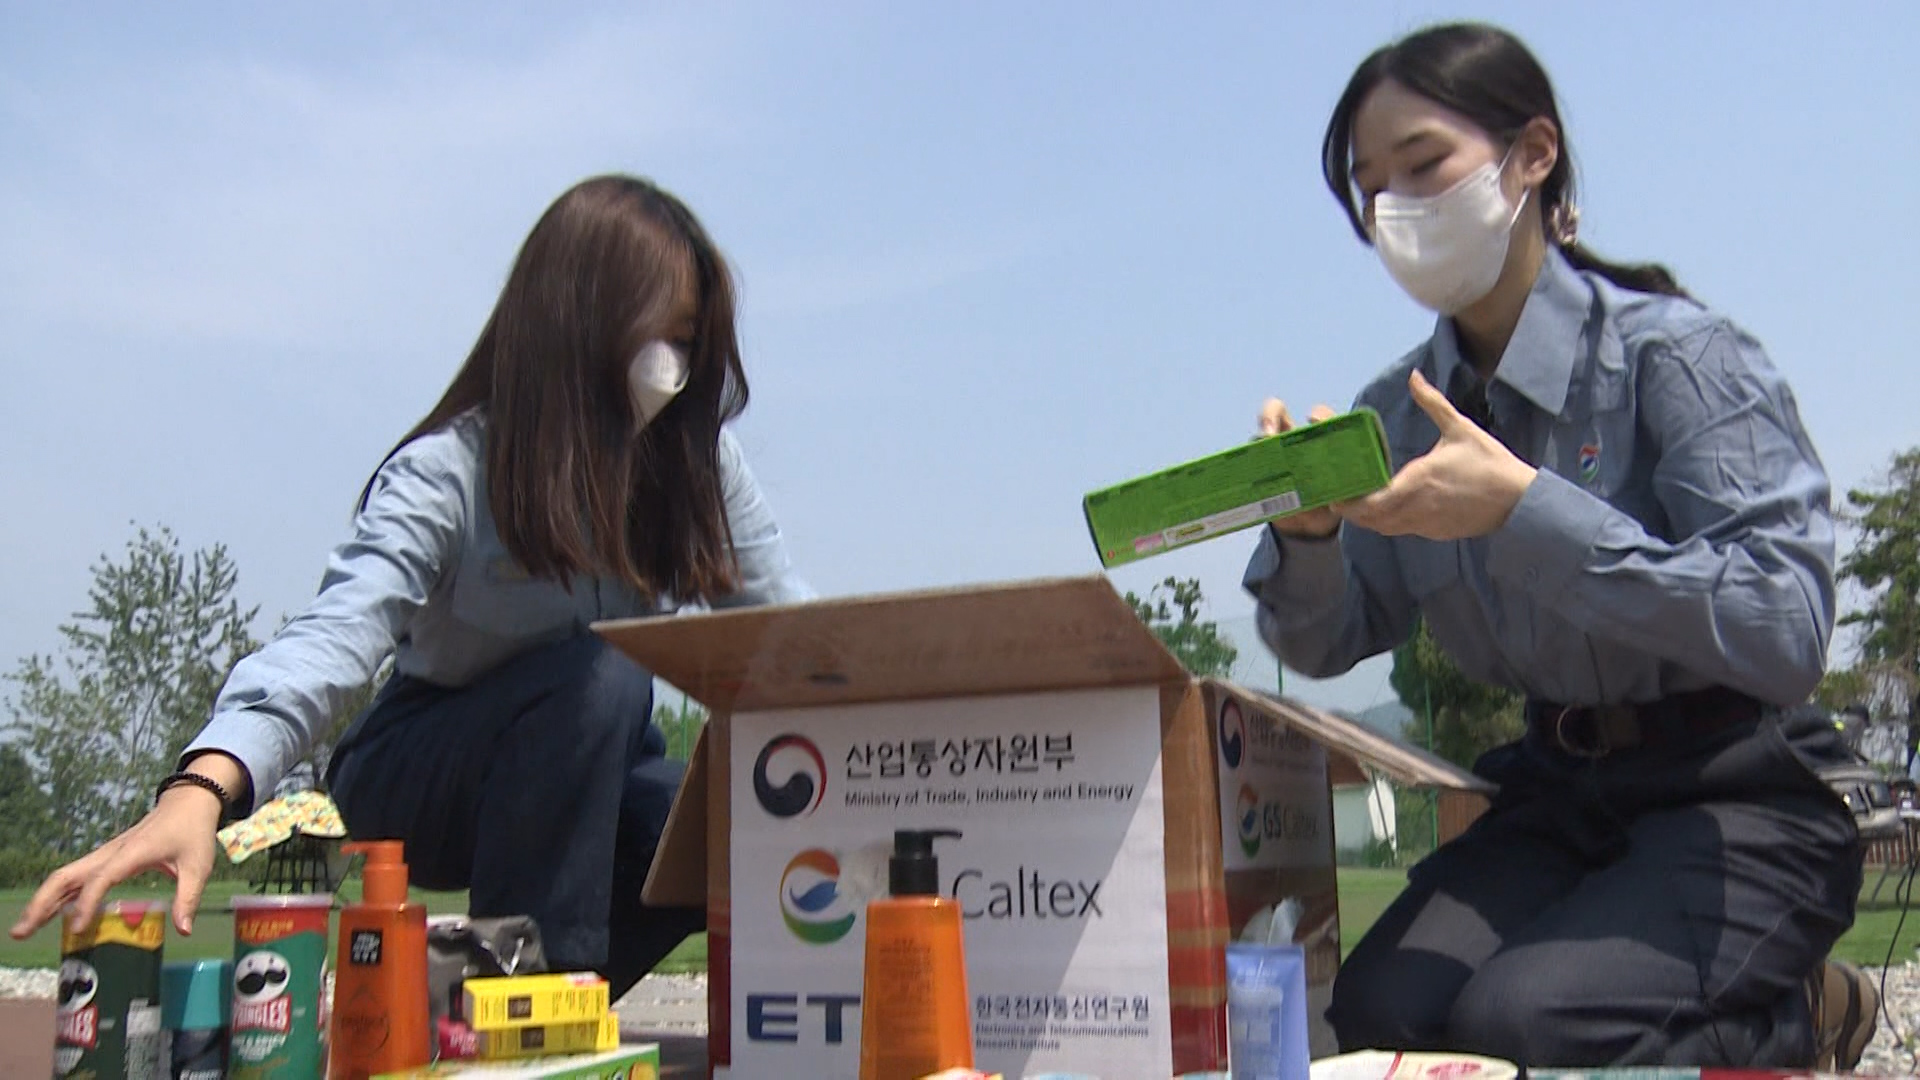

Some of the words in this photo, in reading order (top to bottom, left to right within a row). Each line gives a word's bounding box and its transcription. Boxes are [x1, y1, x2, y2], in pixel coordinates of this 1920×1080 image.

[846, 732, 1075, 779] 산업통상자원부
[845, 790, 900, 808] Ministry
[904, 788, 919, 805] of
[926, 786, 970, 805] Trade,
[976, 783, 1038, 804] Industry
[1042, 783, 1072, 801] and
[1078, 781, 1134, 801] Energy
[952, 865, 1103, 919] Caltex
[747, 992, 861, 1043] ET
[976, 994, 1149, 1020] 한국전자통신연구원
